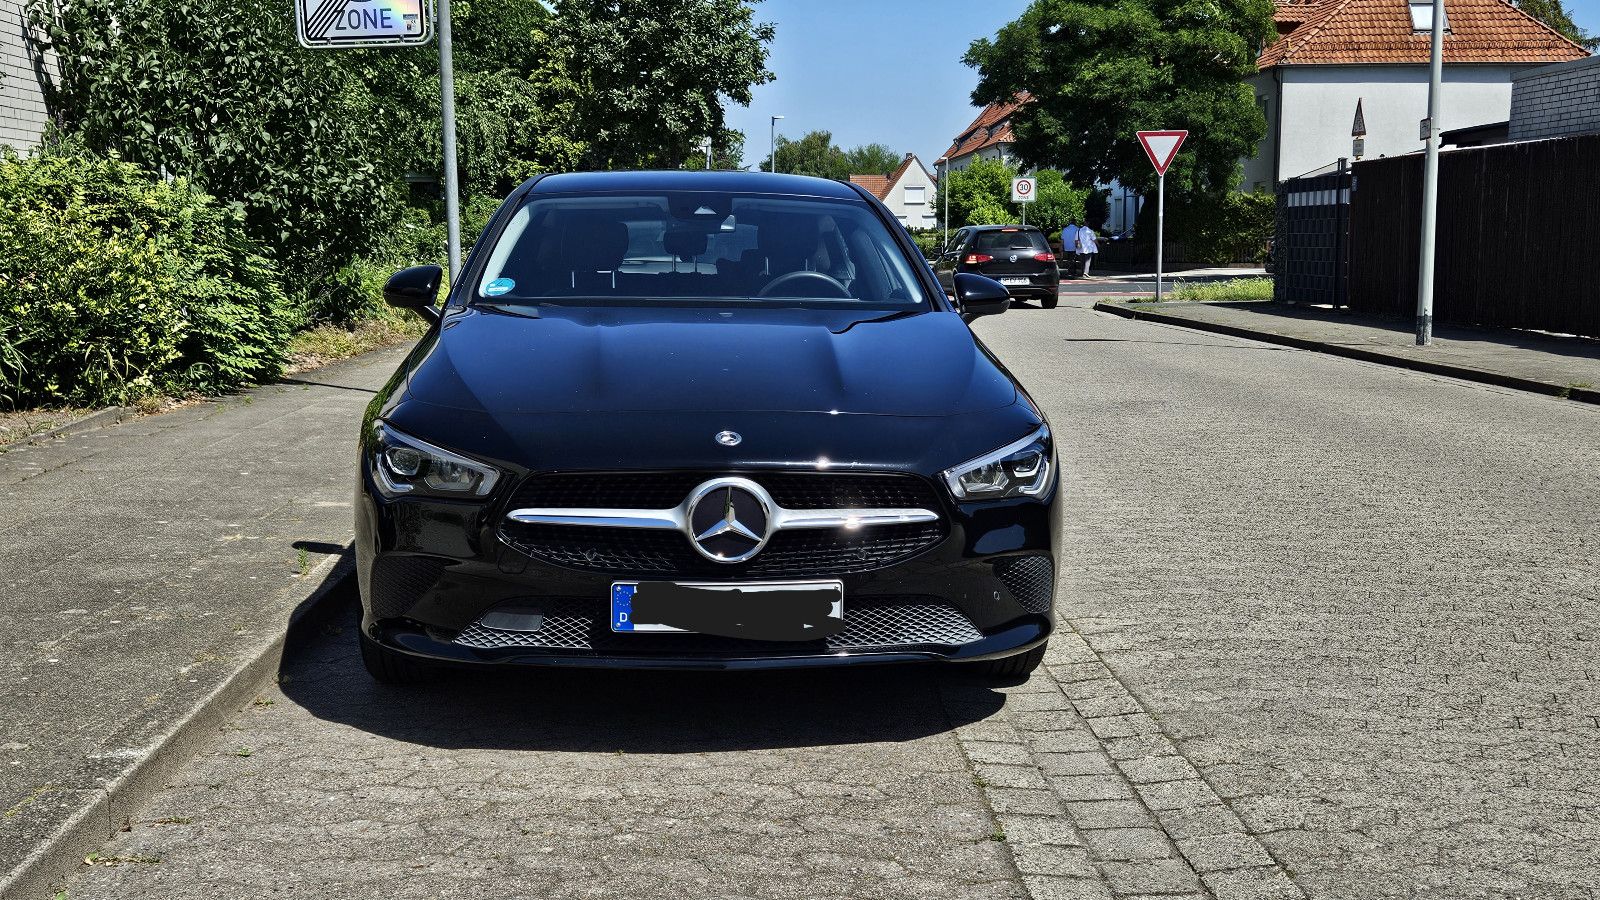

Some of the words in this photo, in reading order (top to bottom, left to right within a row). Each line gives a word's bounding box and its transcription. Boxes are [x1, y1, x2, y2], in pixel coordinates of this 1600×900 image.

[335, 8, 393, 30] ZONE
[1019, 183, 1029, 191] 30
[620, 612, 628, 622] D
